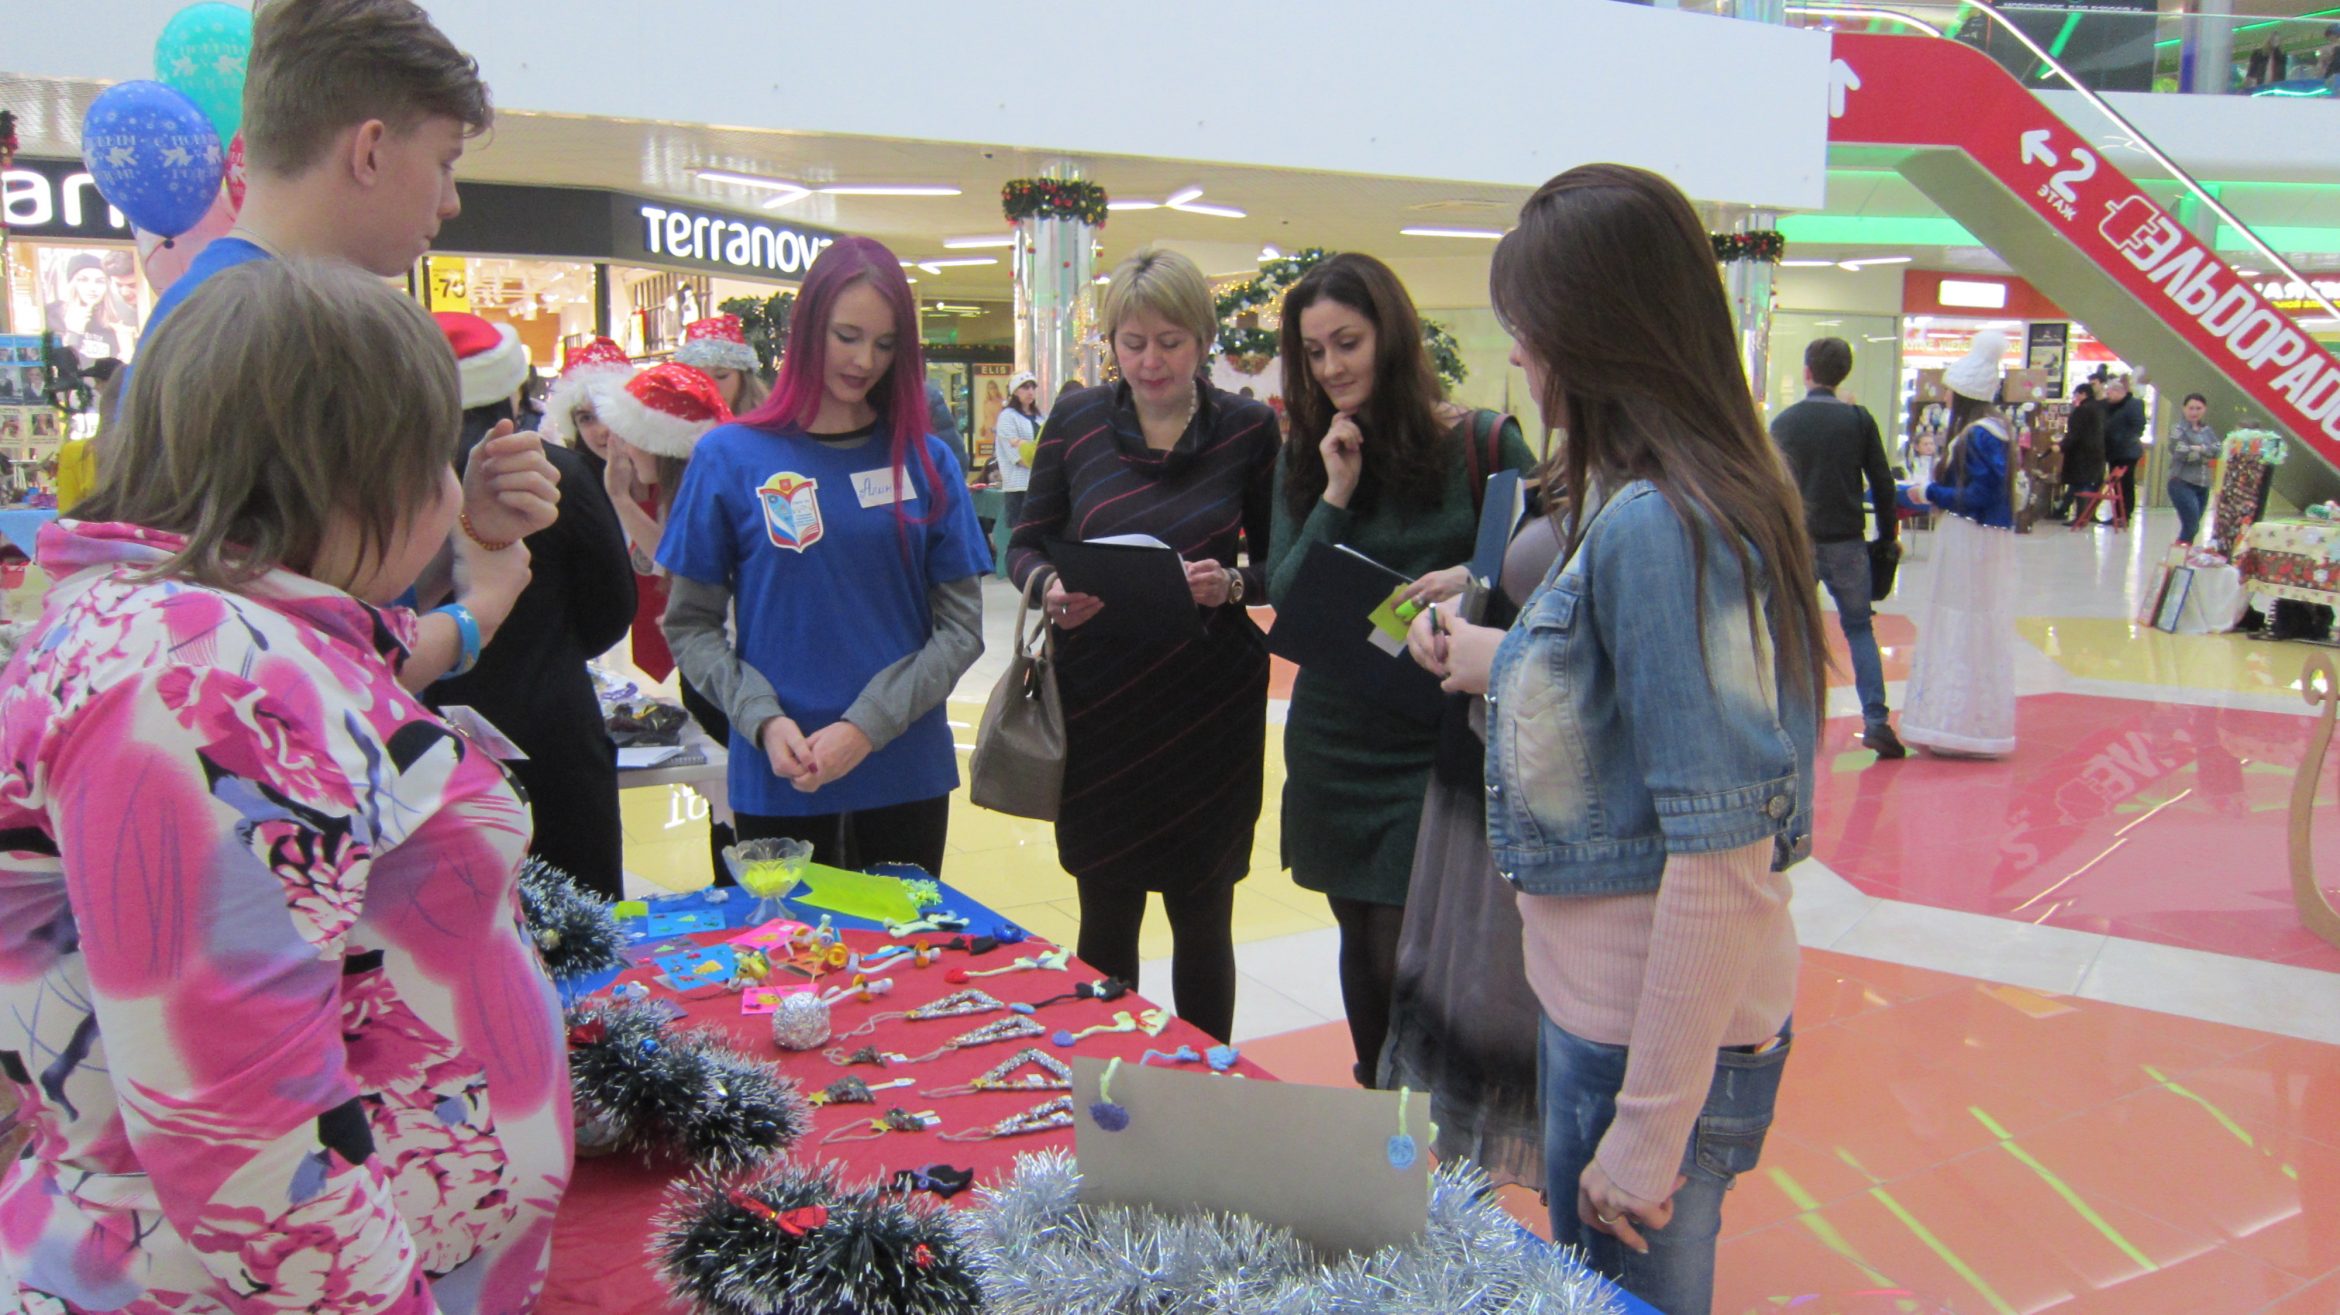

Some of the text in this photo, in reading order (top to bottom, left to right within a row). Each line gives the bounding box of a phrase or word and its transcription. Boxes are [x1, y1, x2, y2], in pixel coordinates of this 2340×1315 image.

[2049, 147, 2097, 203] 2
[2037, 183, 2077, 221] ЭТАЖ
[981, 365, 1007, 375] ELIS
